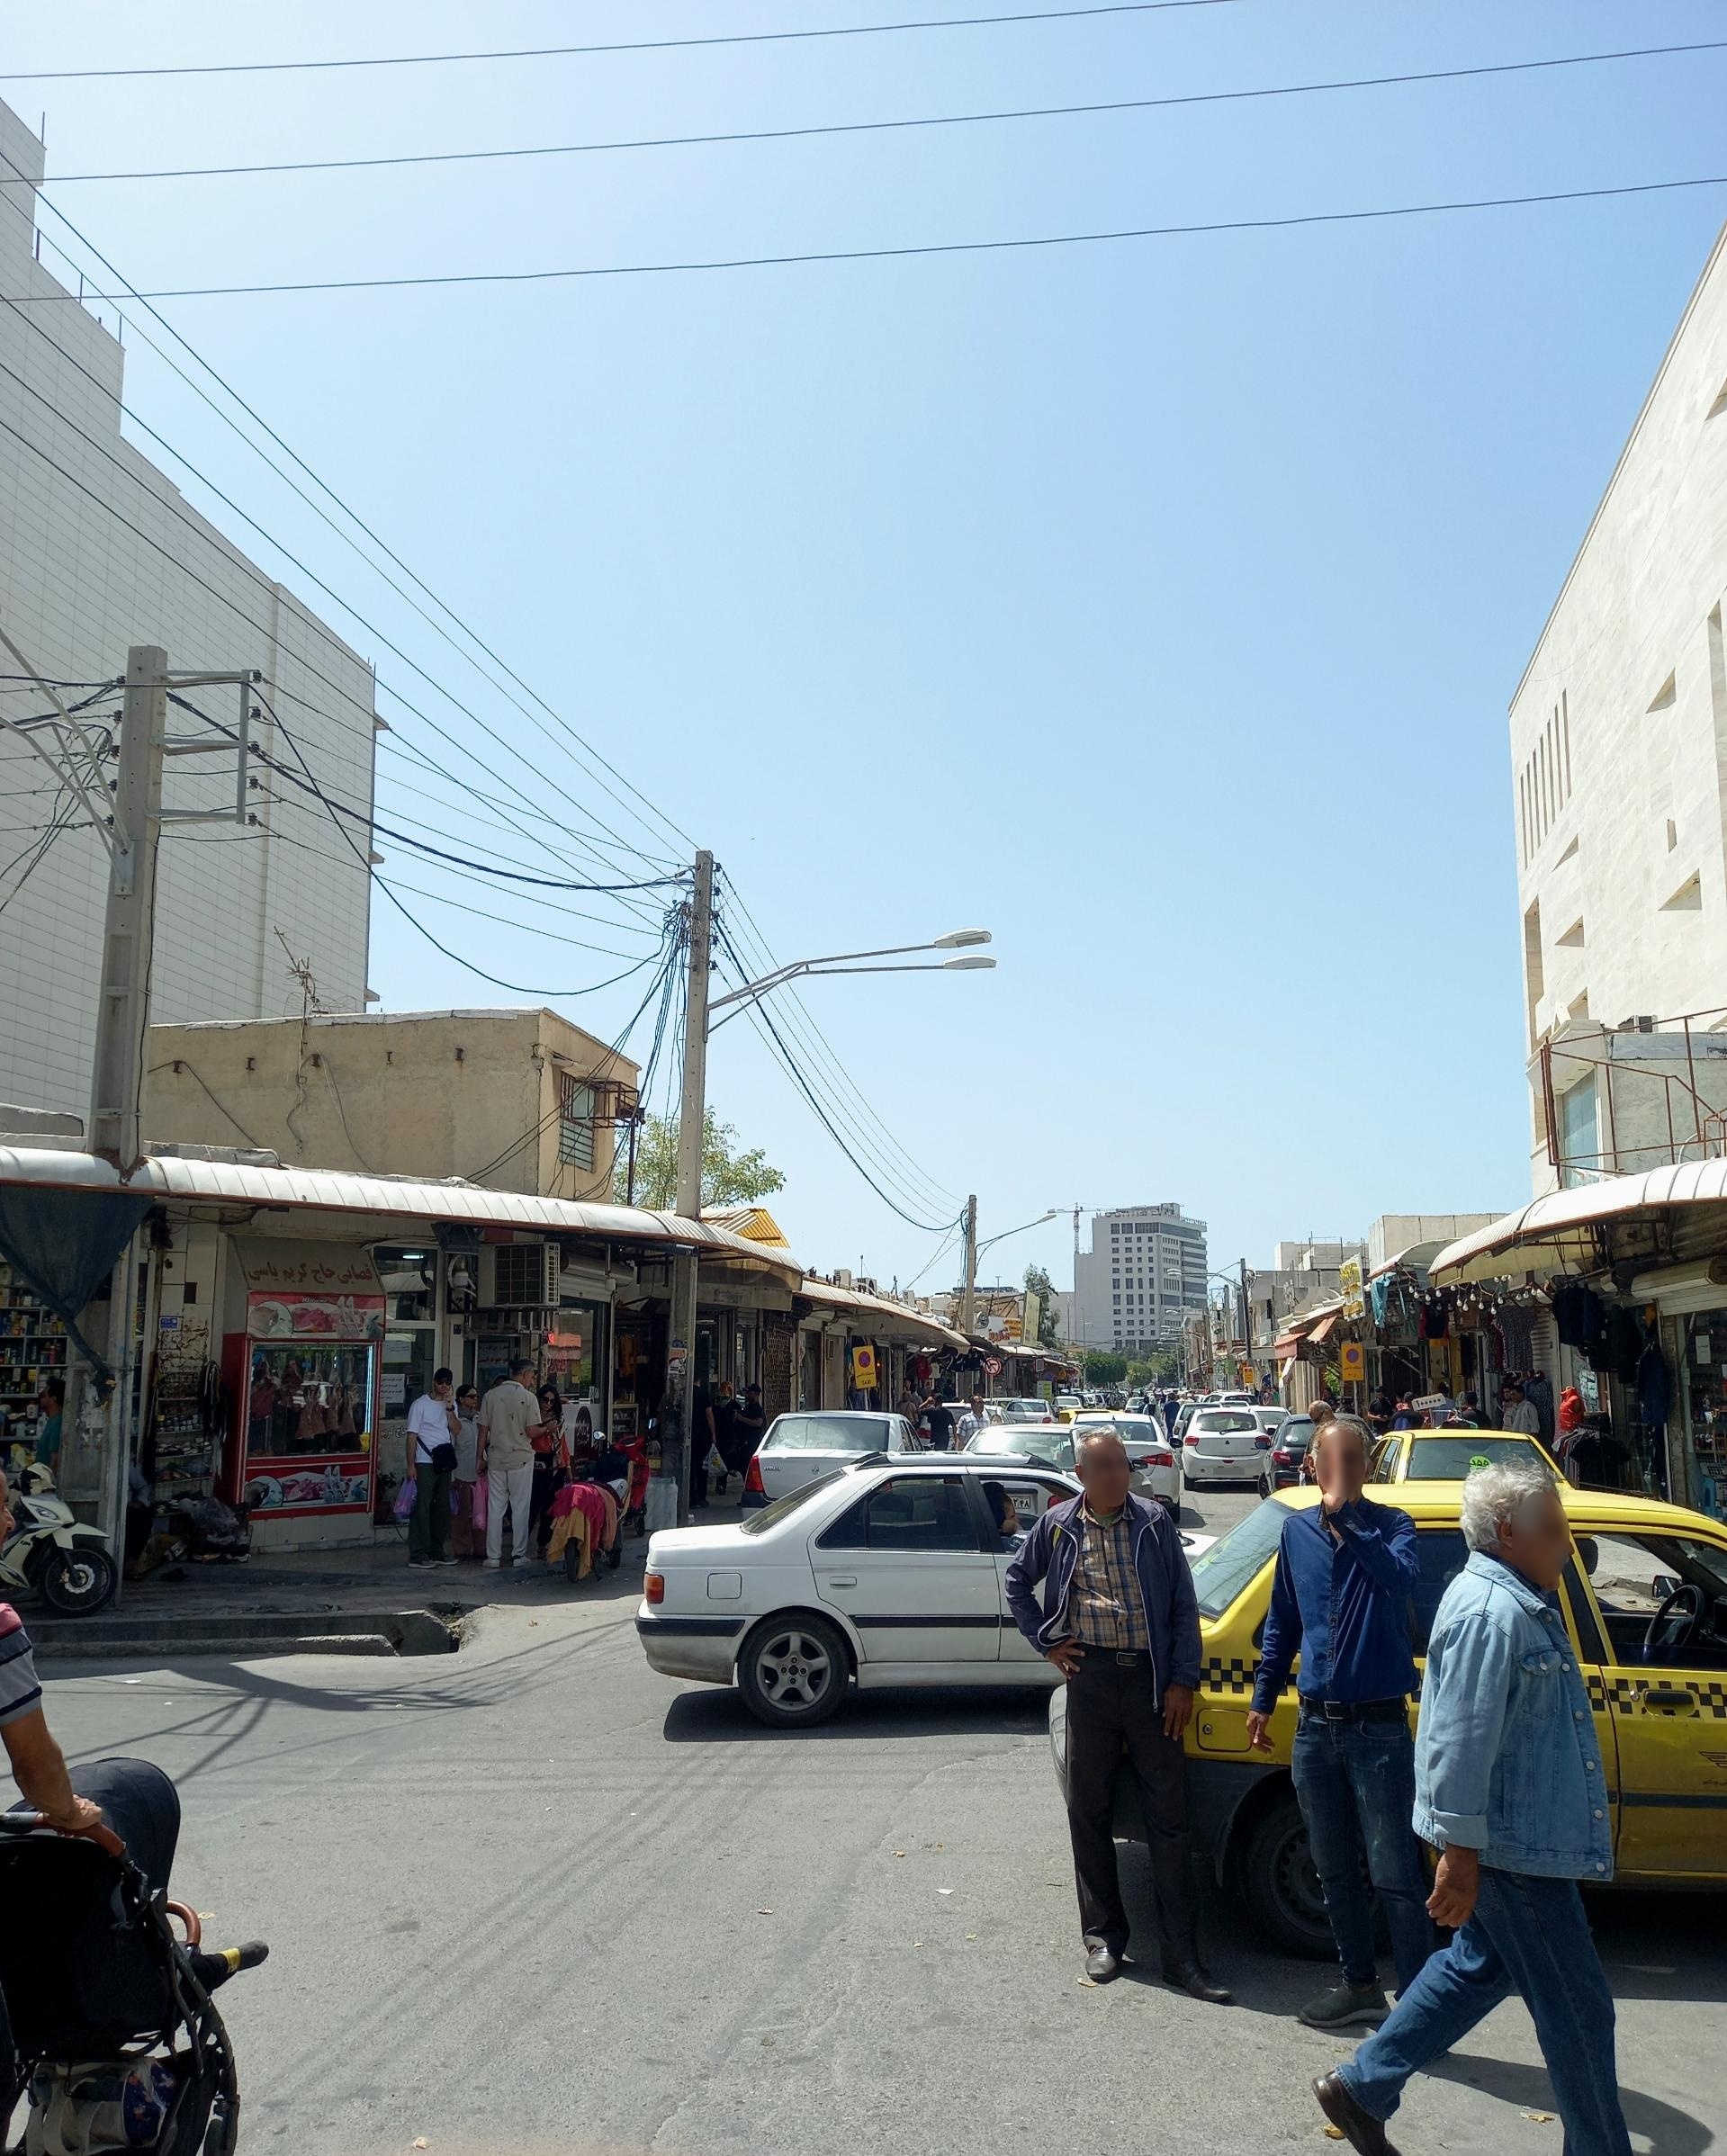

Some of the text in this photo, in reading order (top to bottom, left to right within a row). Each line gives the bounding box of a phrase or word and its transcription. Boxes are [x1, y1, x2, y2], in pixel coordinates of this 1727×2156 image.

[283, 1262, 308, 1282] کریم
[311, 1262, 336, 1284] حاج
[337, 1263, 373, 1284] قصابی
